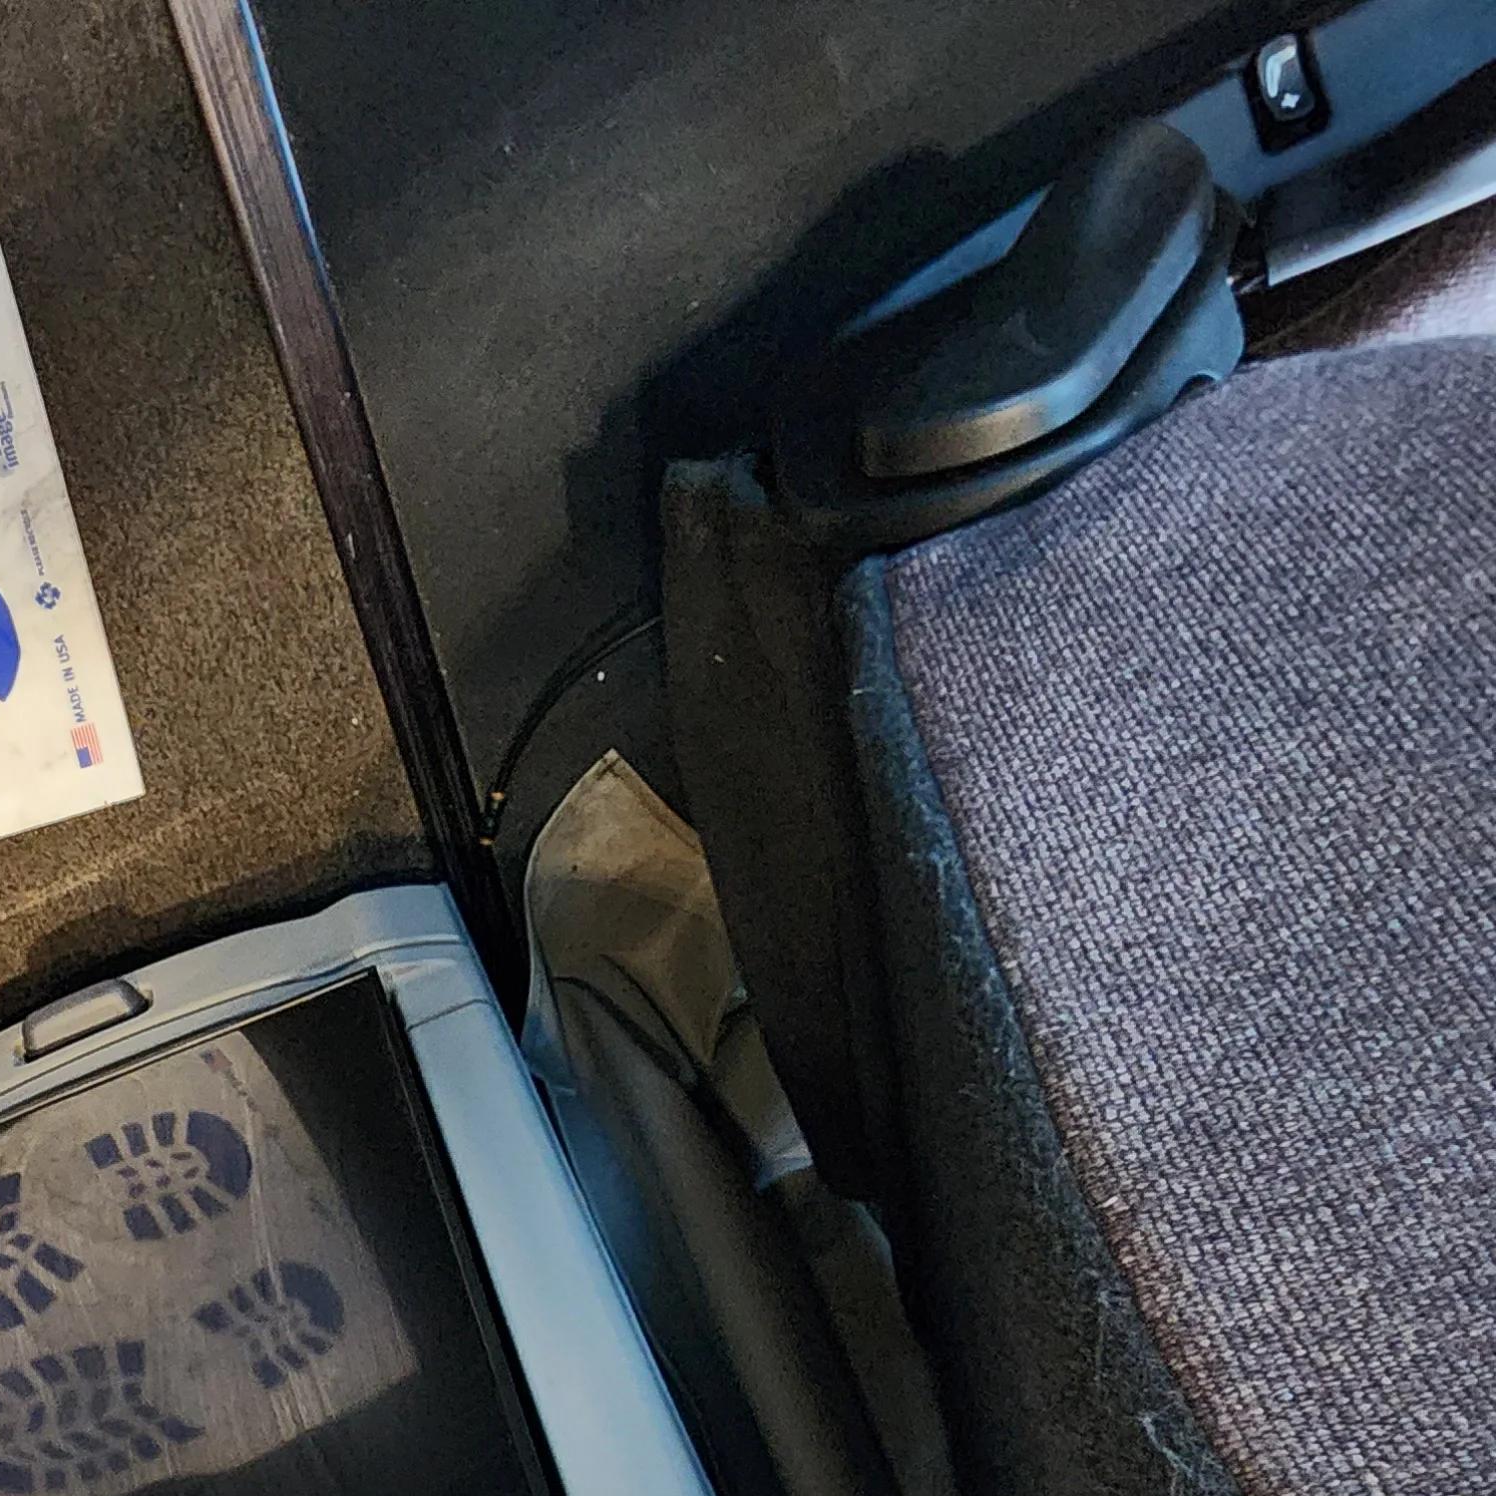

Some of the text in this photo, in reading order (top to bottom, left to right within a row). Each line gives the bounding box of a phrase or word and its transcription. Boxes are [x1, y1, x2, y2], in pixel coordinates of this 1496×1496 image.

[54, 634, 86, 723] MADE IN USA
